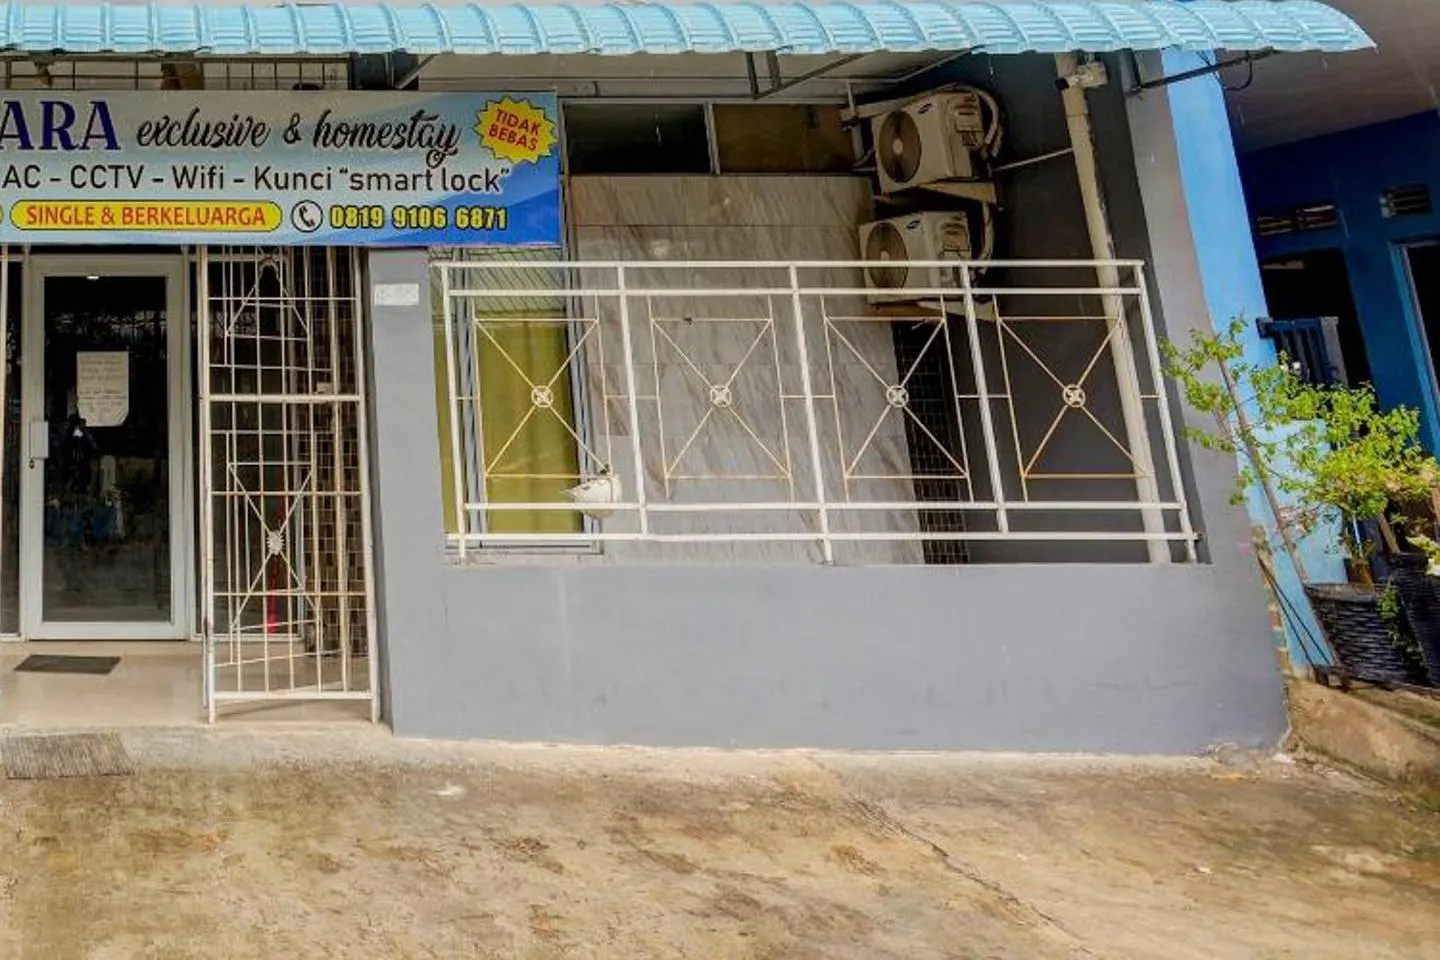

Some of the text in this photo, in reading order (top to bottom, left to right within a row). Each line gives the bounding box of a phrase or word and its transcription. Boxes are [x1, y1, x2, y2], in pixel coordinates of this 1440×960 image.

[495, 108, 541, 136] TIDAK
[136, 107, 271, 148] exclusive
[283, 112, 302, 145] &
[313, 108, 460, 168] homestay
[489, 126, 538, 151] BEBAS
[2, 164, 41, 188] AC
[70, 164, 145, 189] CCTV
[172, 164, 224, 189] Wifi
[254, 165, 332, 190] Kunci
[26, 206, 266, 226] SINGLE & BERKELUARGA
[329, 204, 508, 230] 0819 9106 6871
